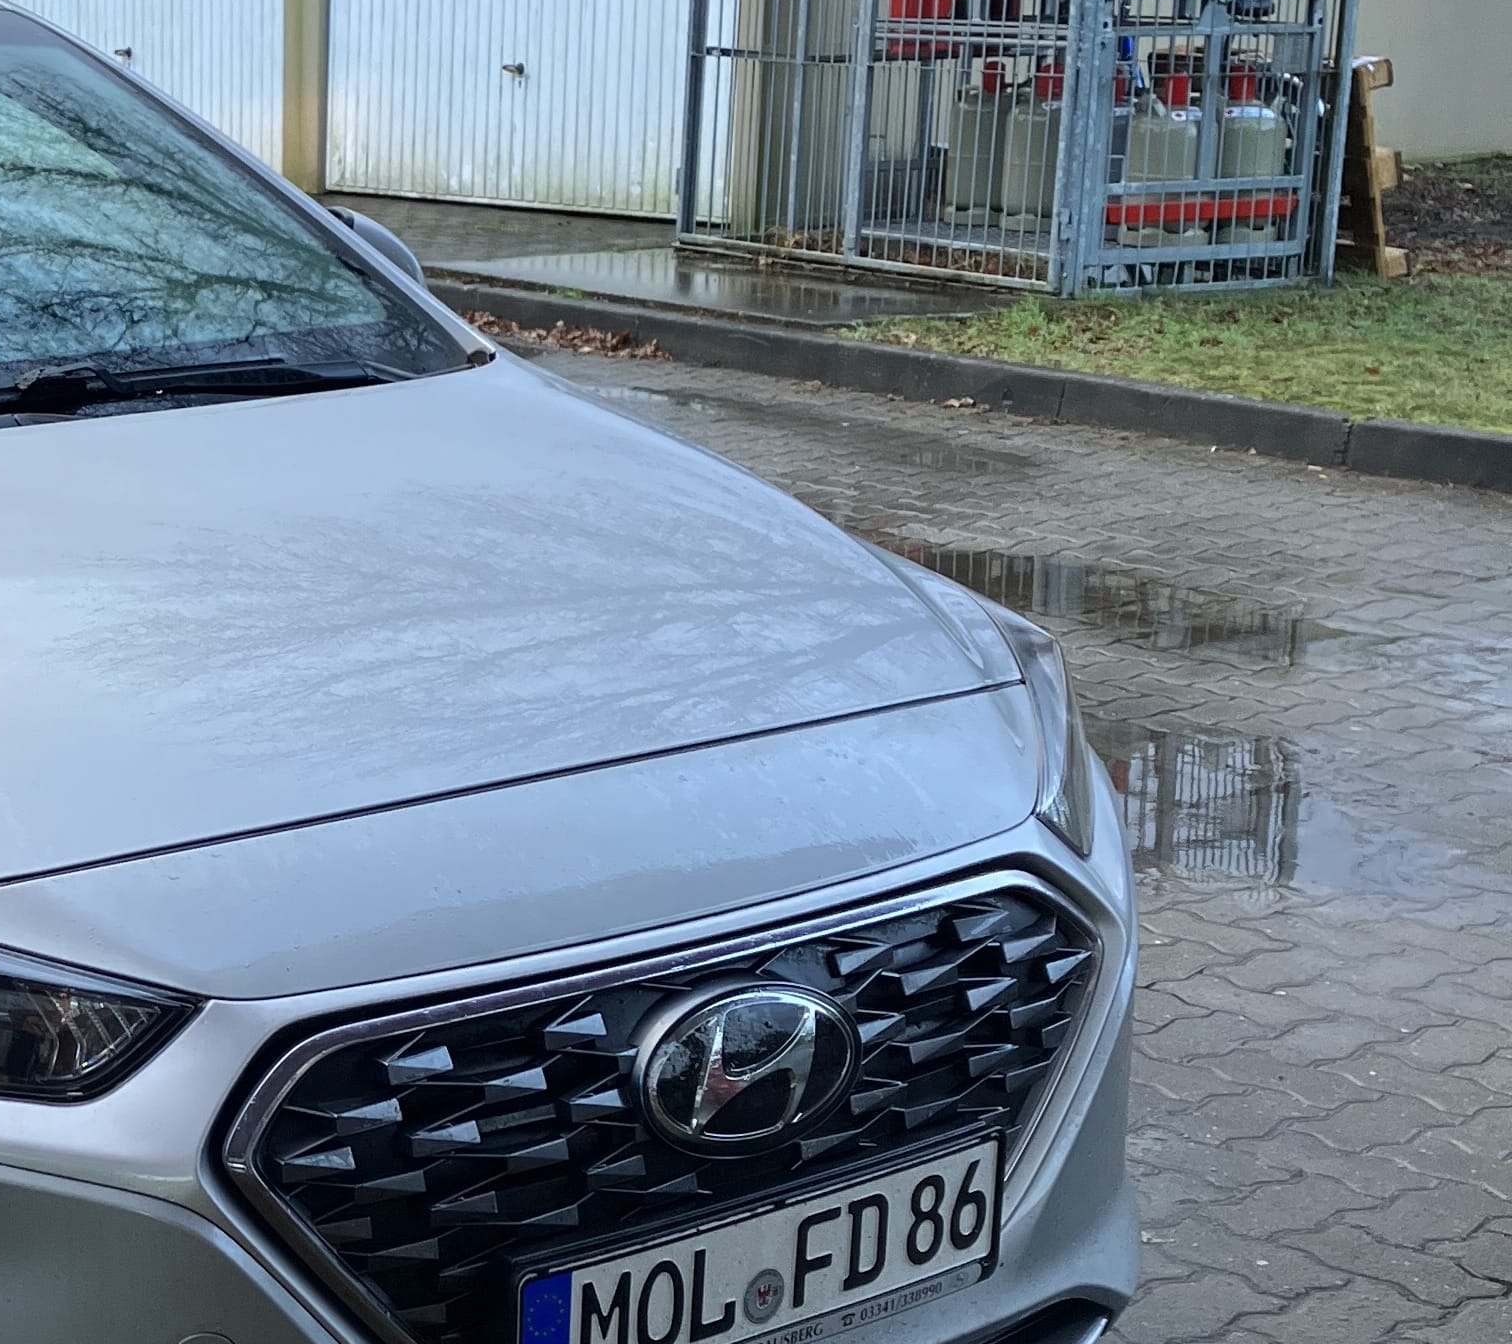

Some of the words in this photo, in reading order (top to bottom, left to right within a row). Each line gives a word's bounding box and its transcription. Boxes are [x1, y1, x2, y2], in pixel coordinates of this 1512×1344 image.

[792, 1193, 889, 1309] FD
[905, 1159, 987, 1266] 86
[859, 1281, 943, 1322] 03341/338990
